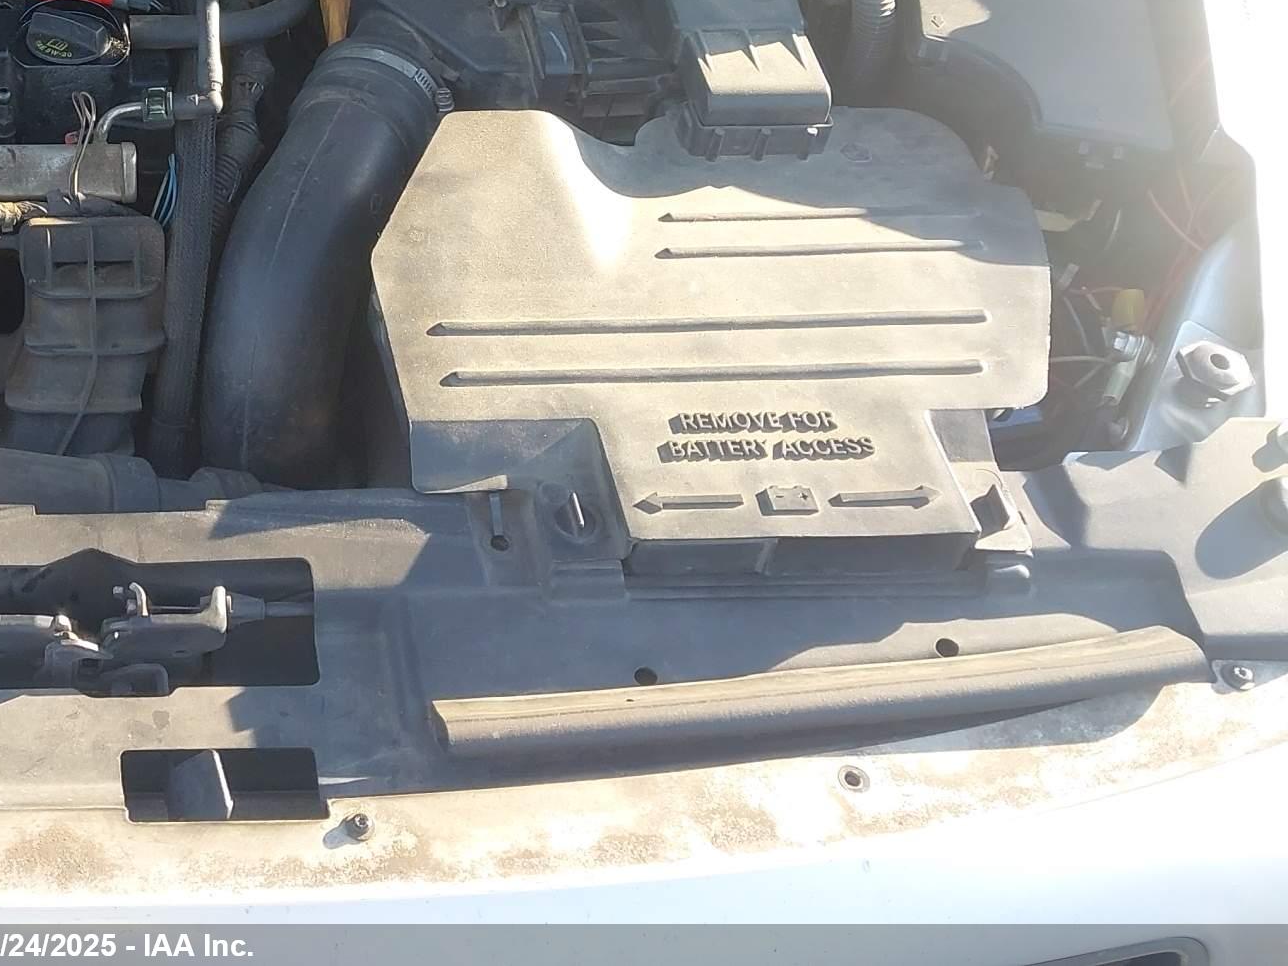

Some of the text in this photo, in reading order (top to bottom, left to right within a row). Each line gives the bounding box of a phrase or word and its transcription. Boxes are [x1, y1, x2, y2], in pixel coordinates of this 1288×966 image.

[671, 410, 838, 433] REMOVE FOR
[660, 436, 876, 462] BATTERY ACCESS
